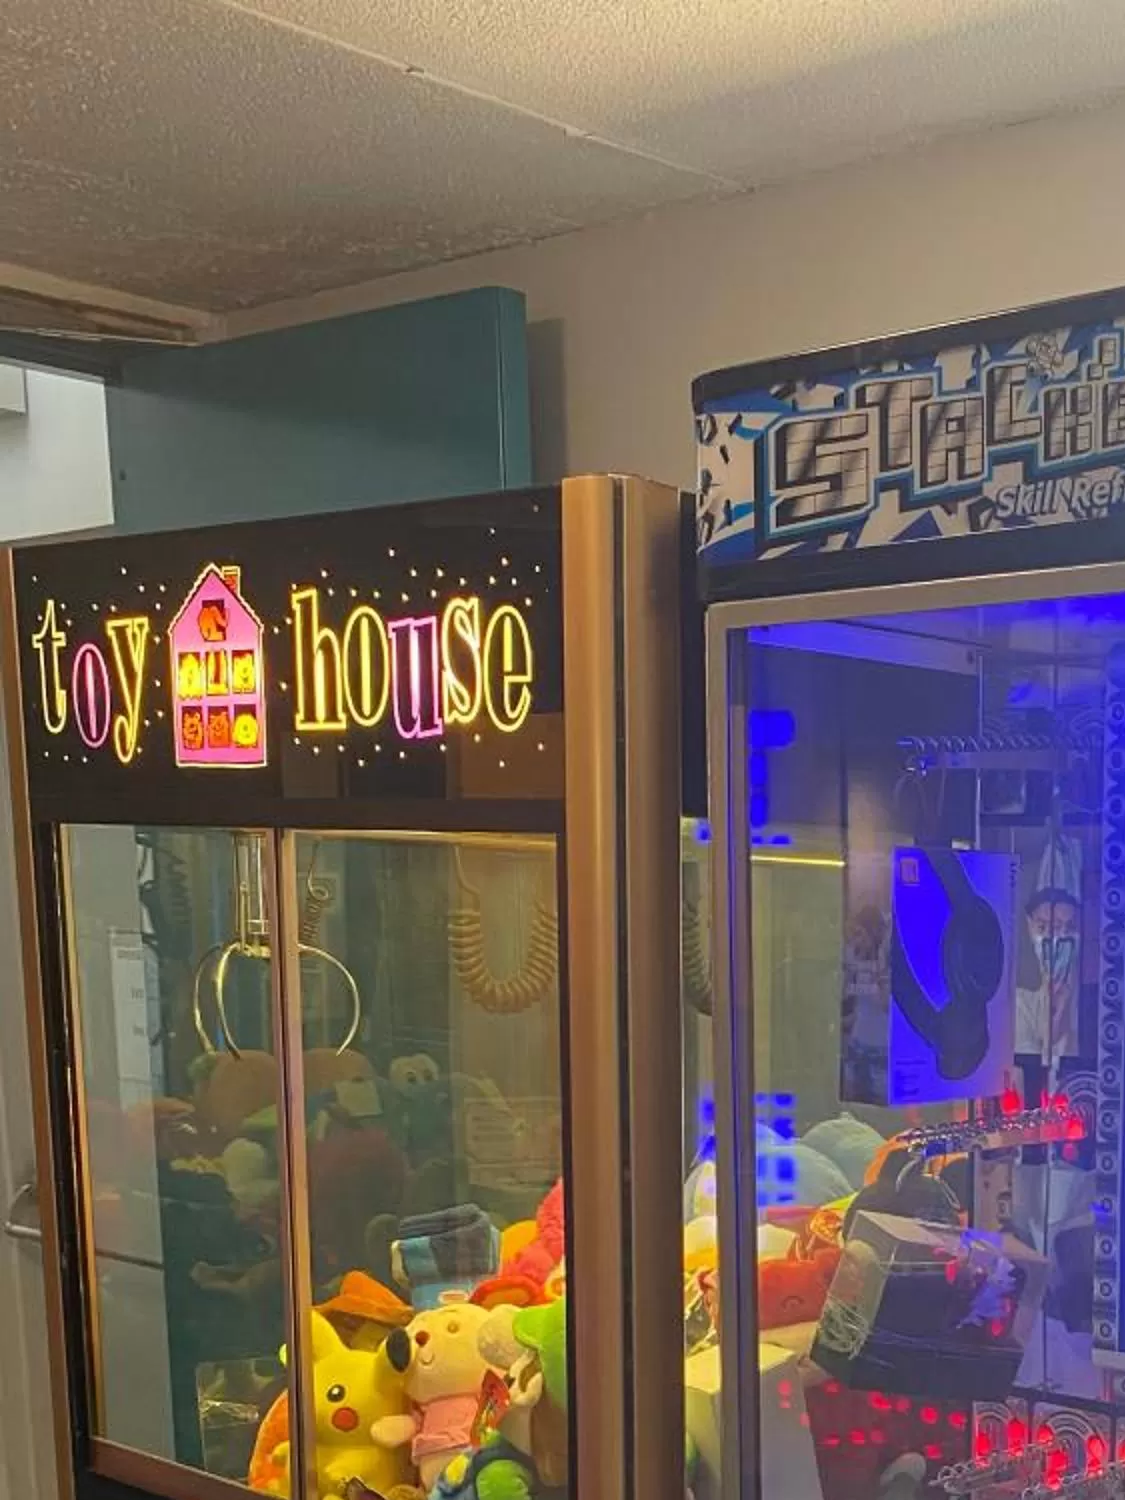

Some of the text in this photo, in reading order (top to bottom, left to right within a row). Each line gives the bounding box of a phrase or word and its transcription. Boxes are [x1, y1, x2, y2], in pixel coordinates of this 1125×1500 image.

[996, 476, 1061, 519] Skill
[32, 588, 533, 764] toy house
